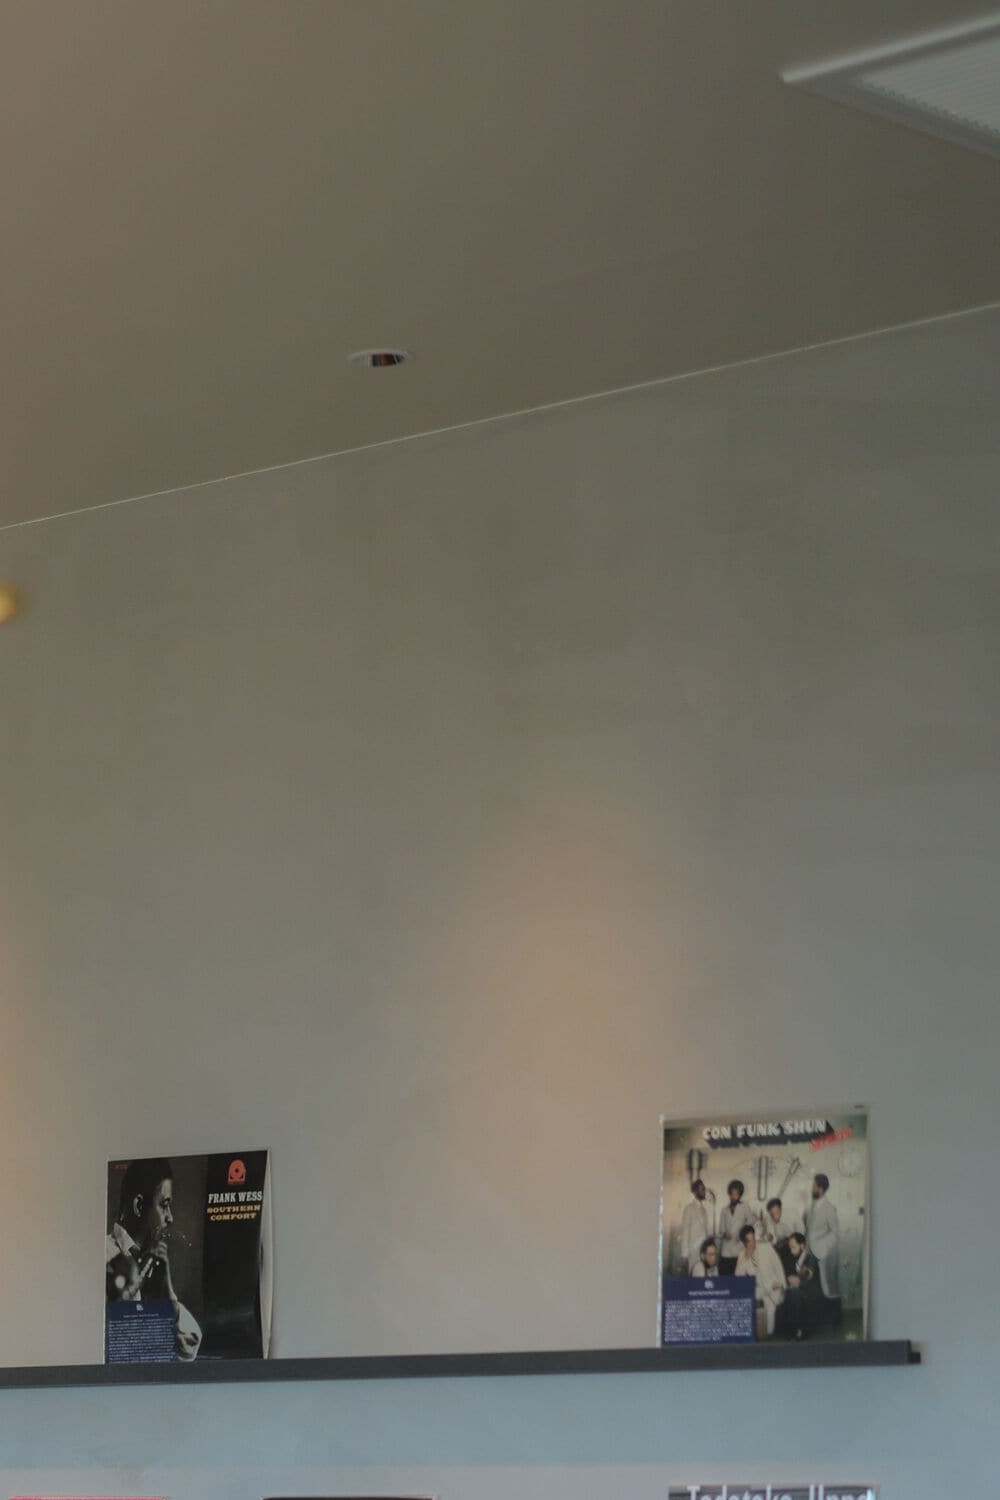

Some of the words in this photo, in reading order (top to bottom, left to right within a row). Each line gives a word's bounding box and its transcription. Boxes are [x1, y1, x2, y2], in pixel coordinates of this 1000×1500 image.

[702, 1126, 731, 1140] CON
[736, 1122, 780, 1138] FUNK
[783, 1119, 827, 1135] SHUN
[208, 1191, 237, 1204] FRANK
[238, 1190, 263, 1202] WESS
[206, 1204, 261, 1214] SOUTHERN
[210, 1212, 257, 1221] COMFORT
